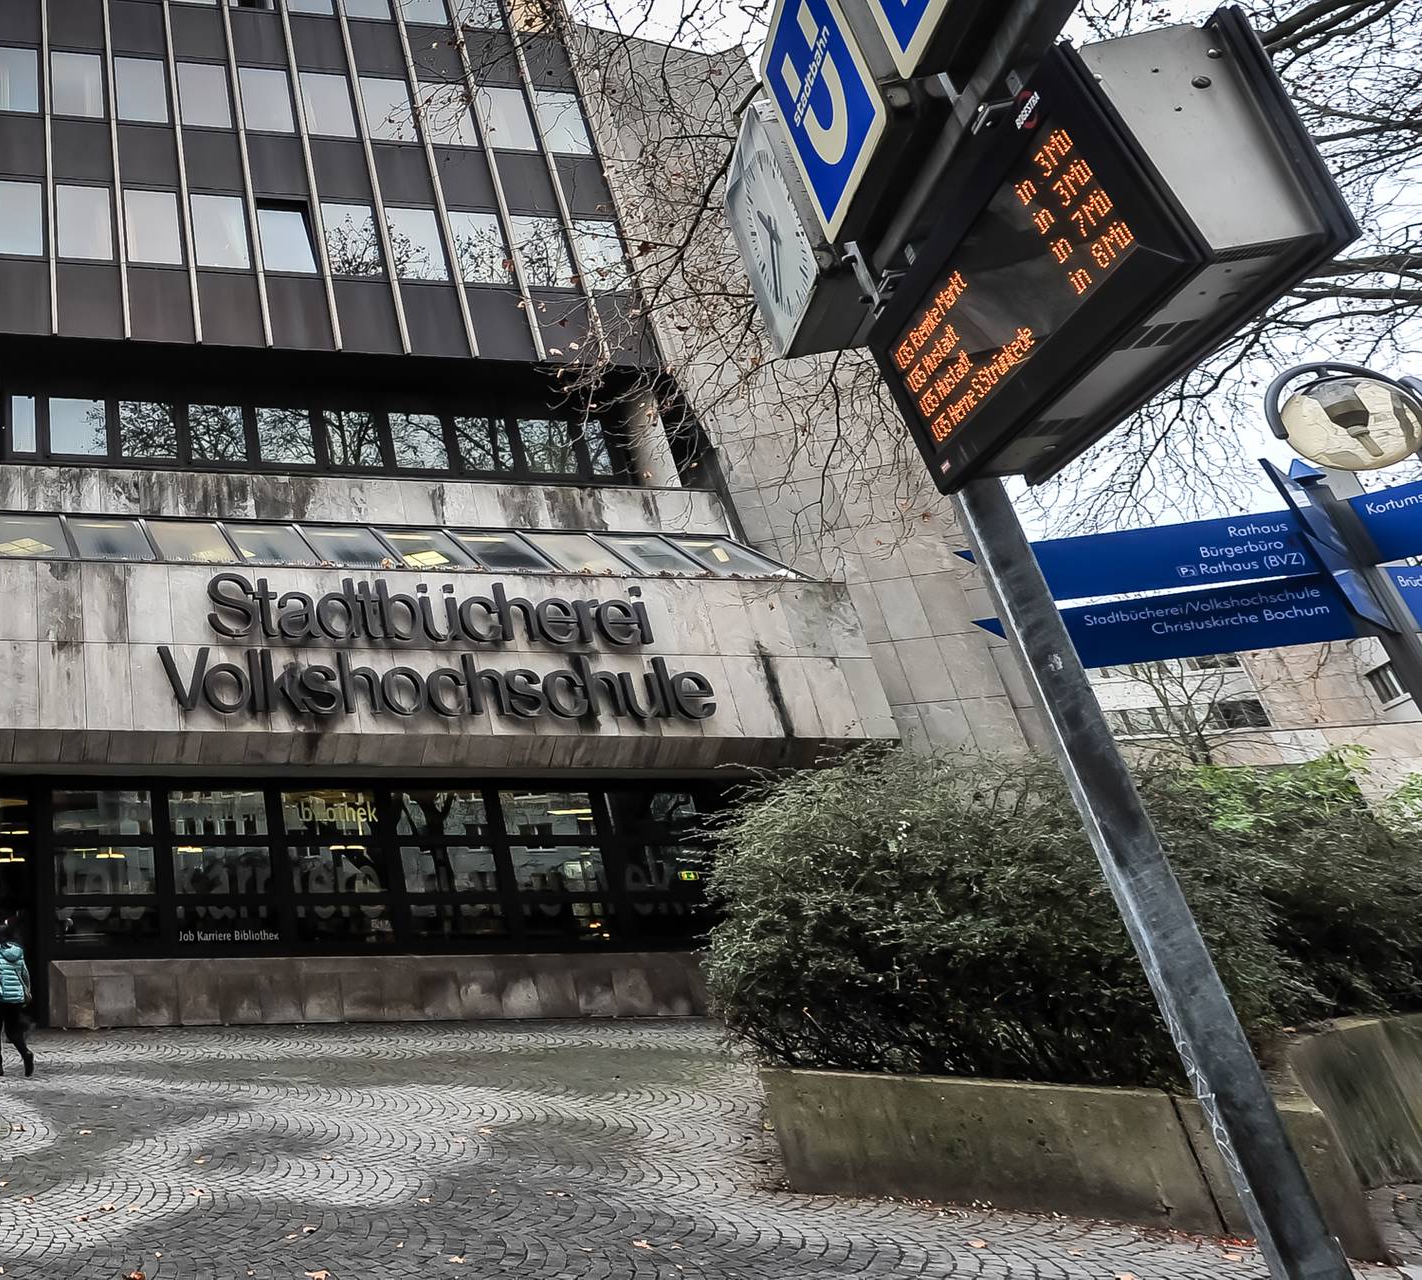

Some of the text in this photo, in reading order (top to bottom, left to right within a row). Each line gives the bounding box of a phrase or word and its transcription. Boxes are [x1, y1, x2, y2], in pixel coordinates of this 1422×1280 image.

[793, 26, 829, 127] stadtbahn
[935, 270, 968, 315] Markt
[1015, 179, 1038, 206] in
[921, 324, 960, 376] Hustadt
[1033, 208, 1055, 235] in
[934, 349, 973, 400] Hustadt
[1049, 238, 1073, 264] in
[946, 389, 978, 426] Herne
[1068, 268, 1093, 295] in
[1199, 561, 1259, 574] Rathaus
[1263, 552, 1306, 570] (BVZ)
[1200, 540, 1284, 558] Bürgerbüro
[1228, 521, 1289, 537] Rathaus
[206, 572, 655, 644] Stadtbücherei
[1084, 586, 1321, 627] Stadtbücherei/Volkshochschule
[1151, 604, 1330, 635] Christuskirche Bochum
[156, 644, 718, 720] Volkshochschule
[179, 929, 280, 942] Job Karriere Bibliothek
